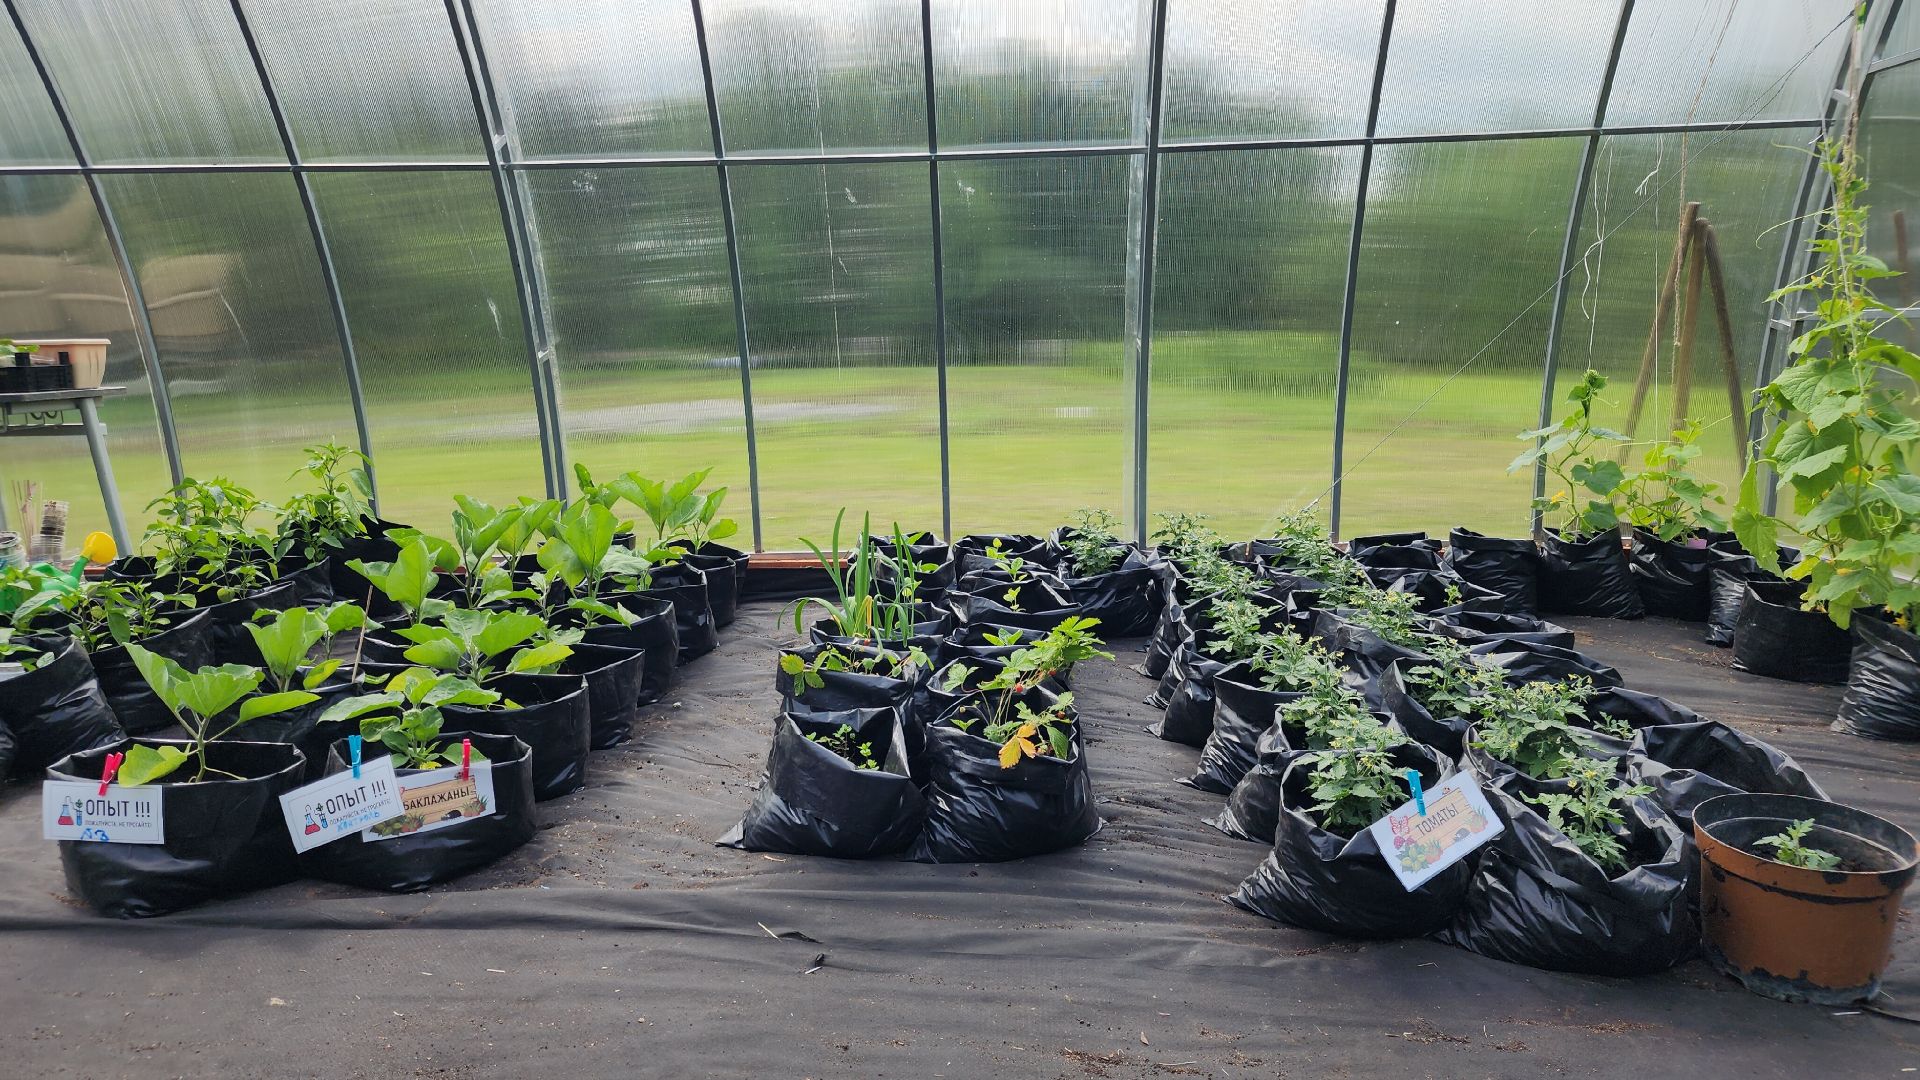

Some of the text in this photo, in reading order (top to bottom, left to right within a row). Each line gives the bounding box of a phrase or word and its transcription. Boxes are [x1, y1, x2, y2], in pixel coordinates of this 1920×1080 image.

[85, 799, 130, 817] ОПЫТ
[325, 786, 367, 815] ОПЫТ
[402, 786, 470, 811] БАКЛАЖАНЫ
[1415, 803, 1460, 837] ТОМАТЫ
